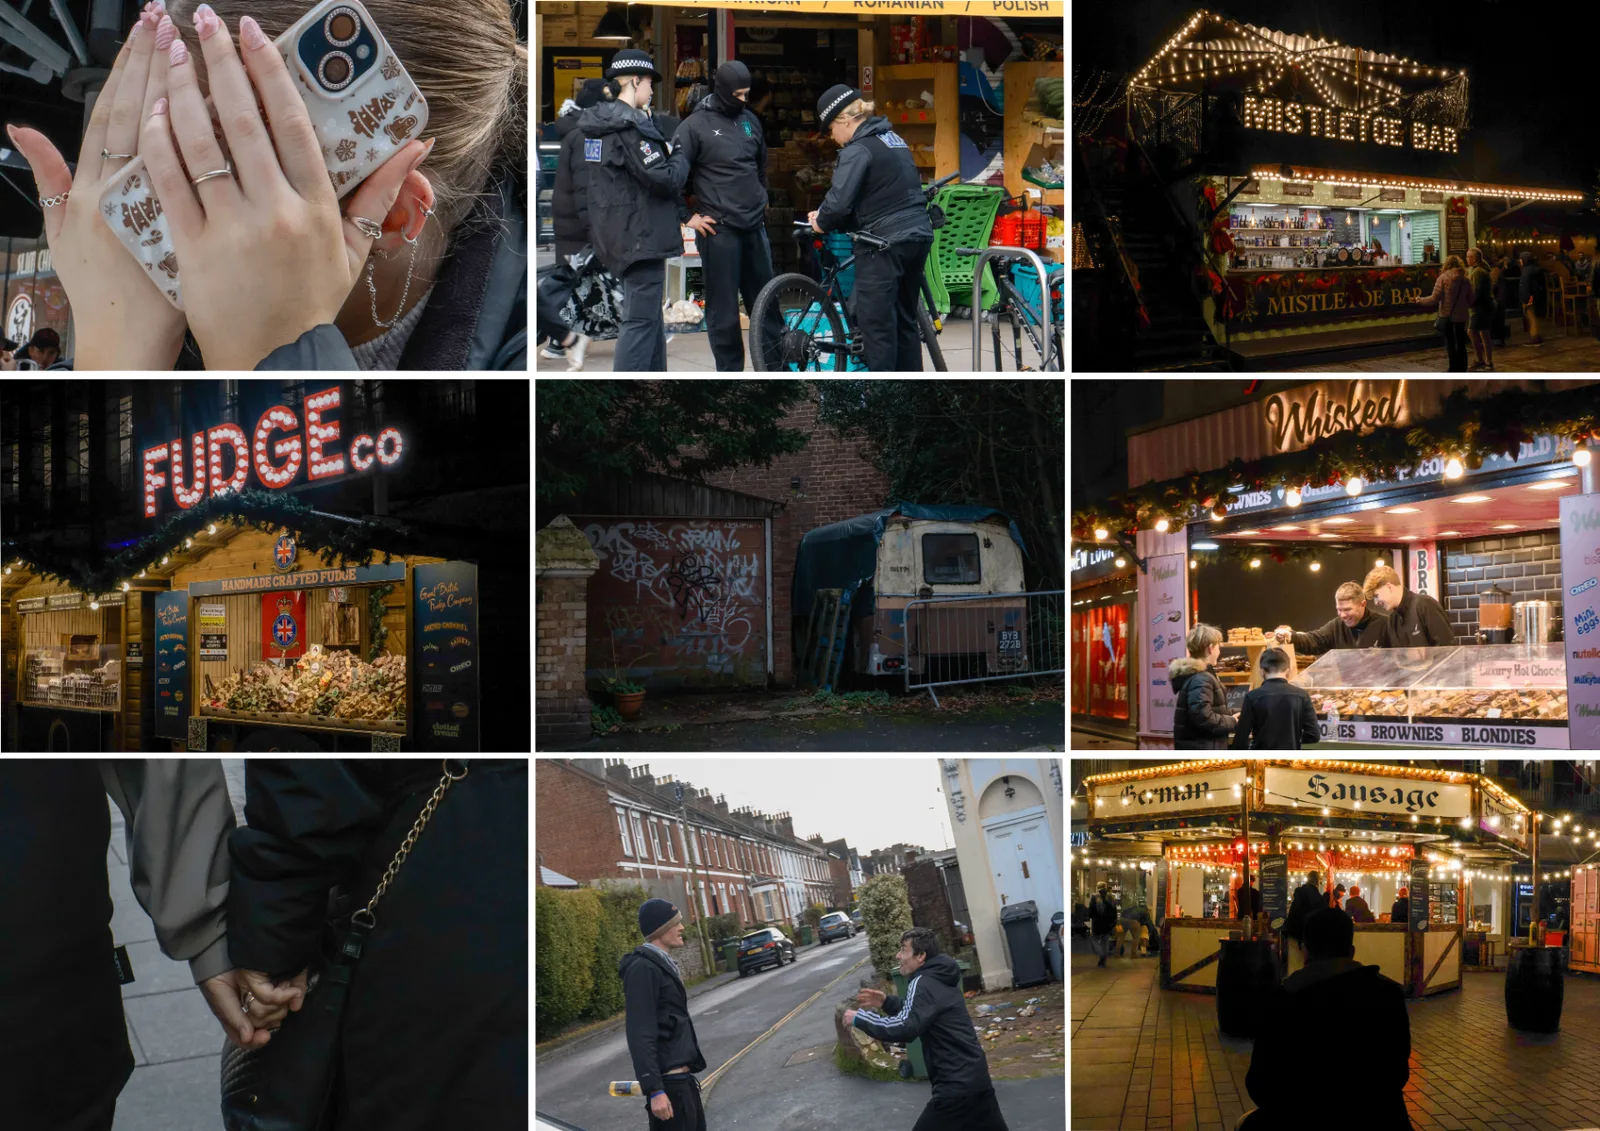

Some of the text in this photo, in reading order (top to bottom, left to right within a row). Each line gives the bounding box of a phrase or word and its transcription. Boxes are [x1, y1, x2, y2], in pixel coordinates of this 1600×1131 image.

[993, 1, 1049, 11] POLISH
[1244, 95, 1460, 154] MISTLETOE BAR
[1265, 380, 1402, 450] Whisked
[143, 386, 345, 520] FUDGE
[221, 568, 357, 592] HANDMADE CRAFTED FUDGE
[1418, 550, 1428, 595] BR
[1570, 577, 1597, 595] OREO
[1574, 606, 1595, 626] Mini
[1577, 616, 1600, 635] eggs
[1000, 640, 1021, 649] 272B
[1001, 631, 1019, 641] BYB
[450, 660, 472, 673] OREO
[1479, 664, 1512, 680] Luxury
[1371, 725, 1444, 741] BROWNIES
[1461, 727, 1537, 745] BLONDIES
[1120, 781, 1209, 805] German
[1306, 774, 1439, 812] Sausage
